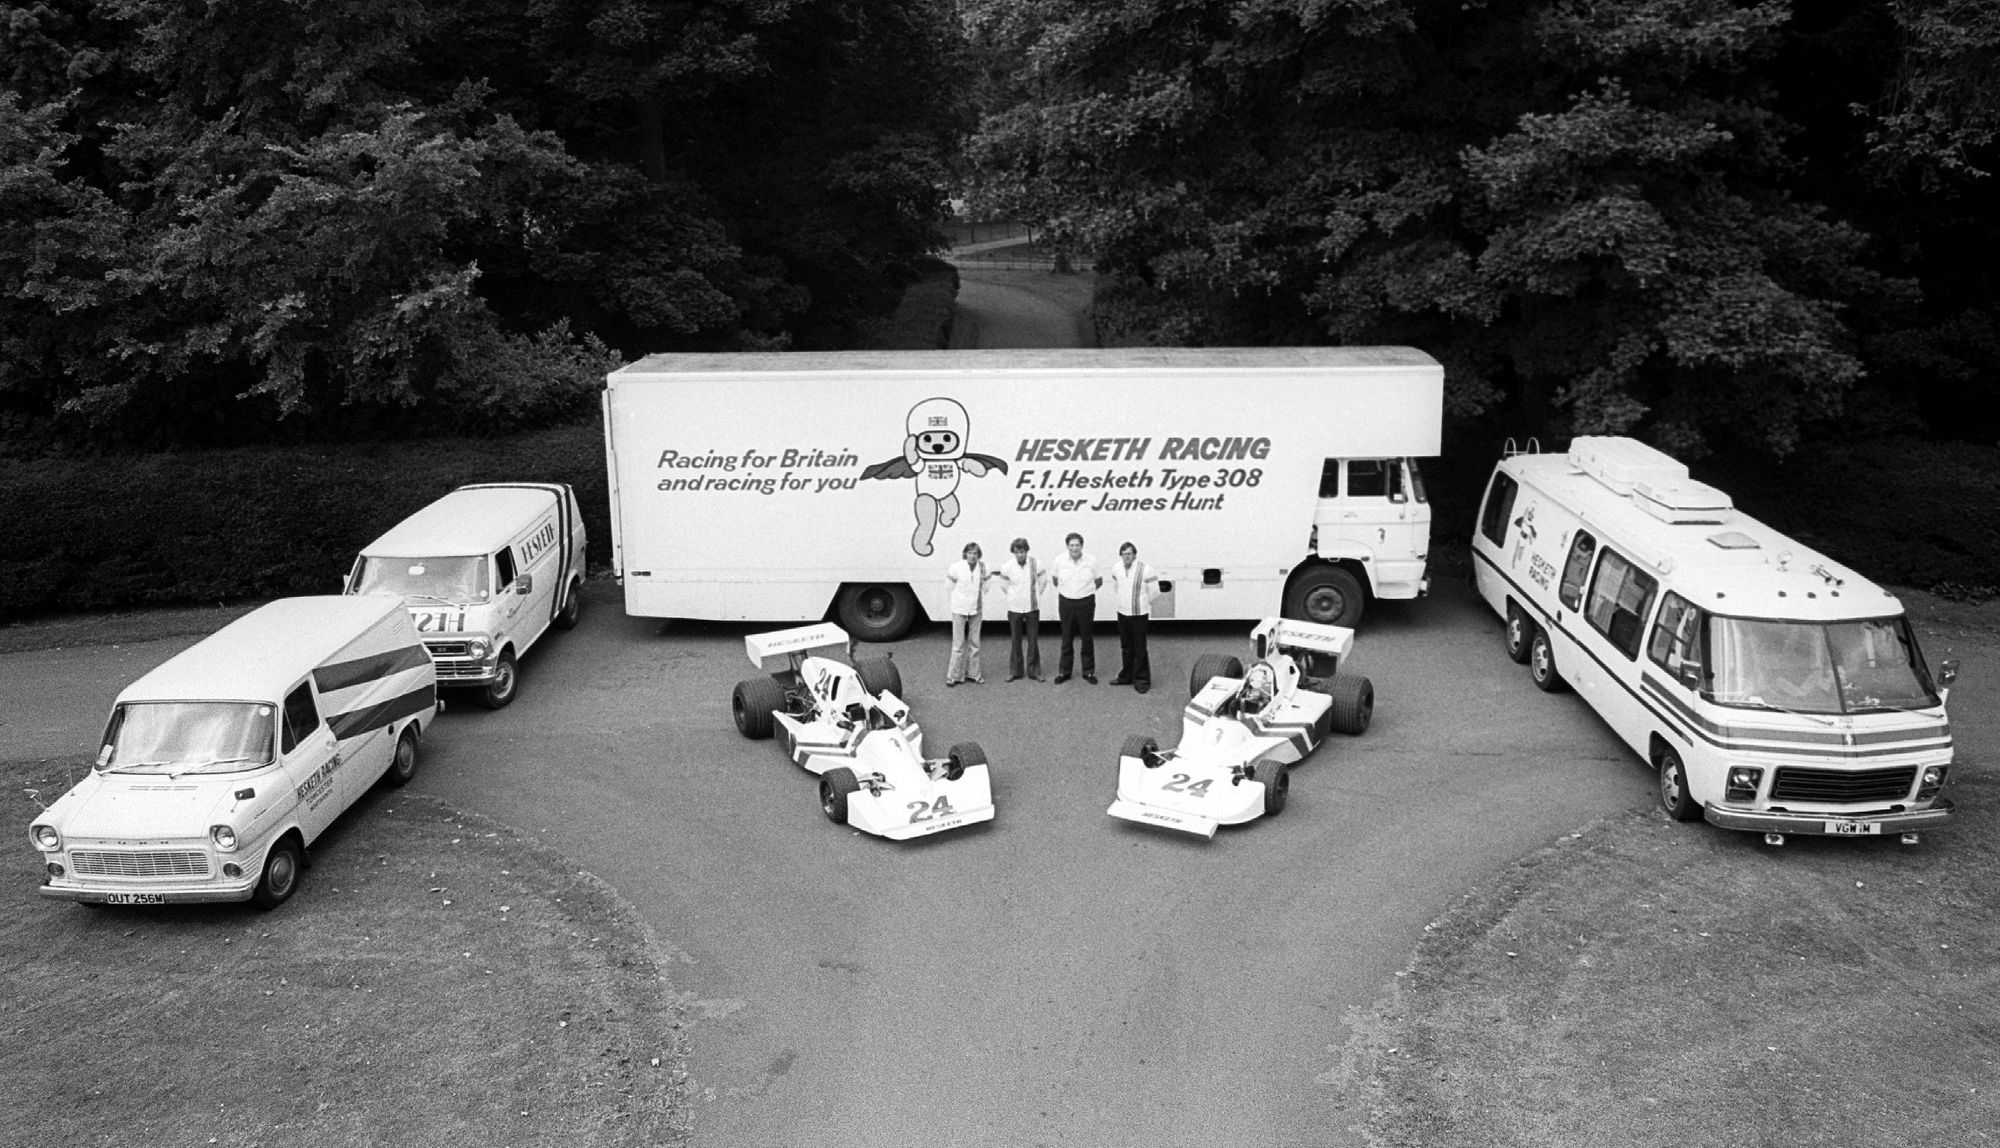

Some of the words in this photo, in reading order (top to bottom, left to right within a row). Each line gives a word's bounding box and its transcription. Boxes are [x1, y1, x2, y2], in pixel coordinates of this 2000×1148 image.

[657, 449, 738, 471] Racing
[740, 449, 777, 468] for
[780, 448, 858, 468] Britain
[1015, 438, 1151, 461] HESKETH
[1158, 437, 1271, 460] RACING
[657, 474, 704, 491] and
[704, 473, 776, 495] racing
[780, 472, 812, 490] for
[815, 478, 858, 493] you
[1159, 469, 1211, 490] Type
[1213, 468, 1263, 487] 308
[1016, 492, 1088, 511] Driver
[1091, 492, 1168, 511] James
[1170, 491, 1224, 511] Hunt
[814, 668, 832, 701] 24
[1161, 773, 1214, 798] 24
[906, 795, 953, 824] 24
[1835, 823, 1857, 833] VGW
[108, 893, 130, 904] OUT
[133, 893, 164, 904] 256M
